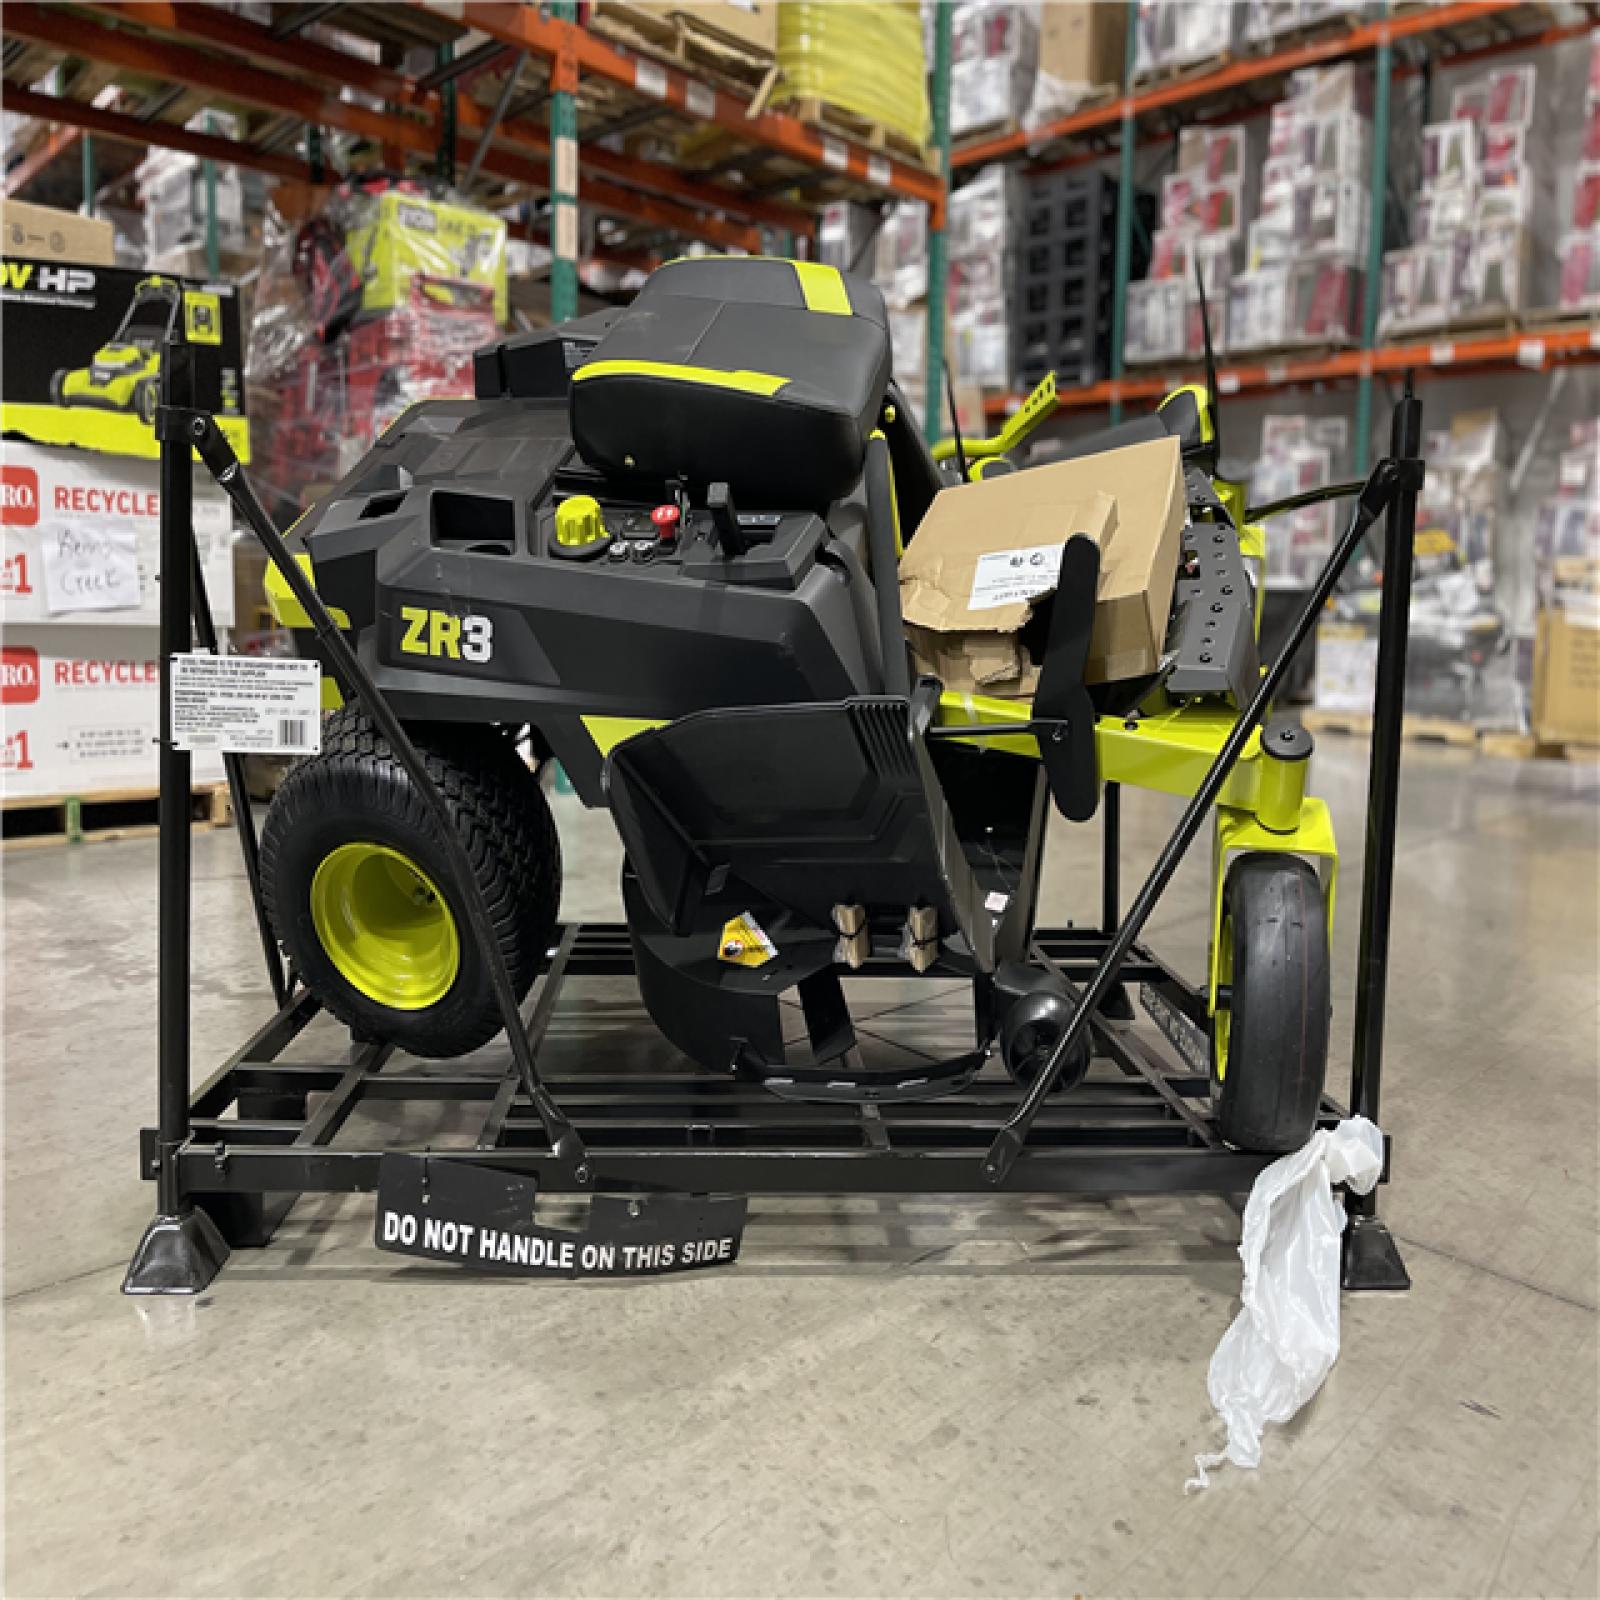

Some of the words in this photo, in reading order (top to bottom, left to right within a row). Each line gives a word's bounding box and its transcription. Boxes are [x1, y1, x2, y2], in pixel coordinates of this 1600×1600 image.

[37, 266, 96, 293] HP
[401, 606, 493, 663] ZR3
[54, 659, 160, 685] RECYCLE
[384, 1210, 416, 1246] DO
[423, 1217, 474, 1255] NOT
[479, 1228, 575, 1269] HANDLE
[581, 1243, 614, 1270] ON
[622, 1243, 675, 1270] THIS
[681, 1237, 733, 1263] SIDE
